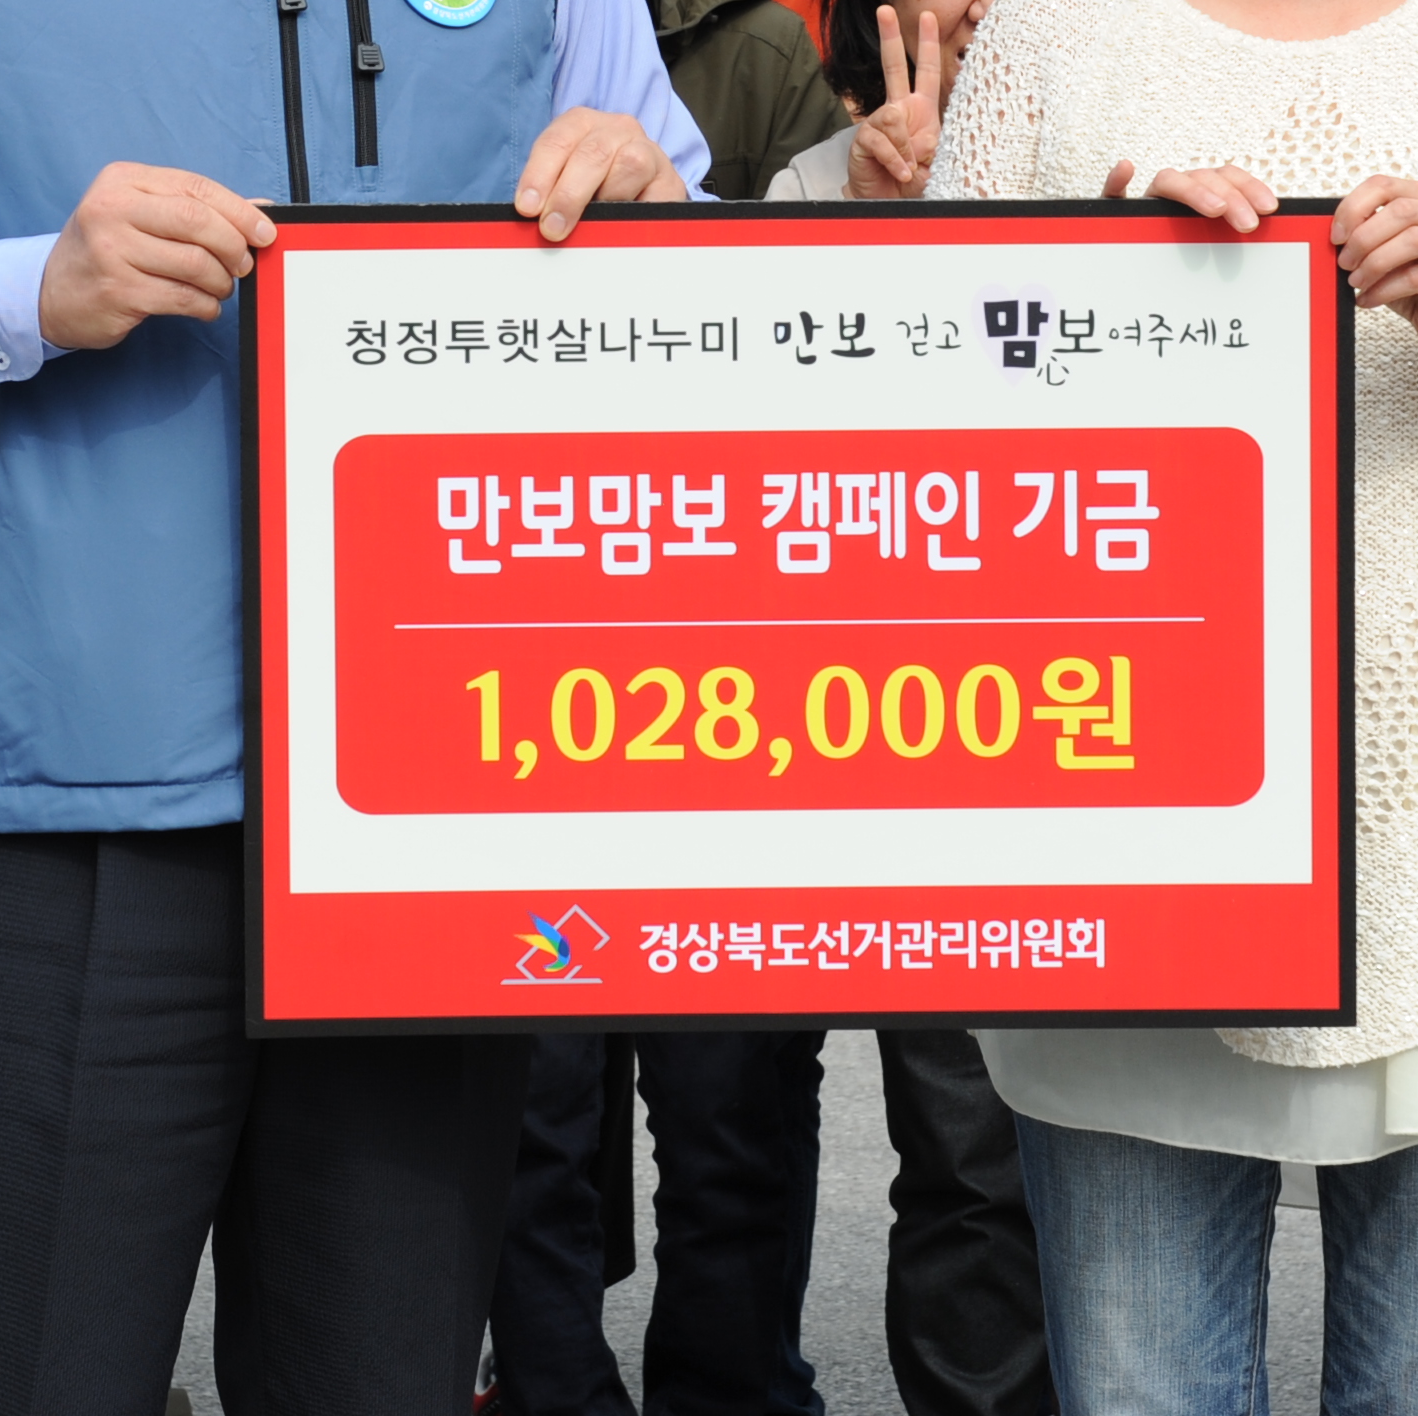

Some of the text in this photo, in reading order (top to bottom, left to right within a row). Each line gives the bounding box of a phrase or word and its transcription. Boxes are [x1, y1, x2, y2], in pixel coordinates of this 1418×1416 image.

[346, 316, 739, 366] 청정투햇살나누미
[773, 311, 876, 365] 만보
[895, 313, 962, 356] 걷고
[437, 469, 1160, 576] 만보맘보 캠페인 기금
[466, 656, 1135, 780] 1,028,000원
[639, 917, 1106, 974] 경상북도선거관리위원회
